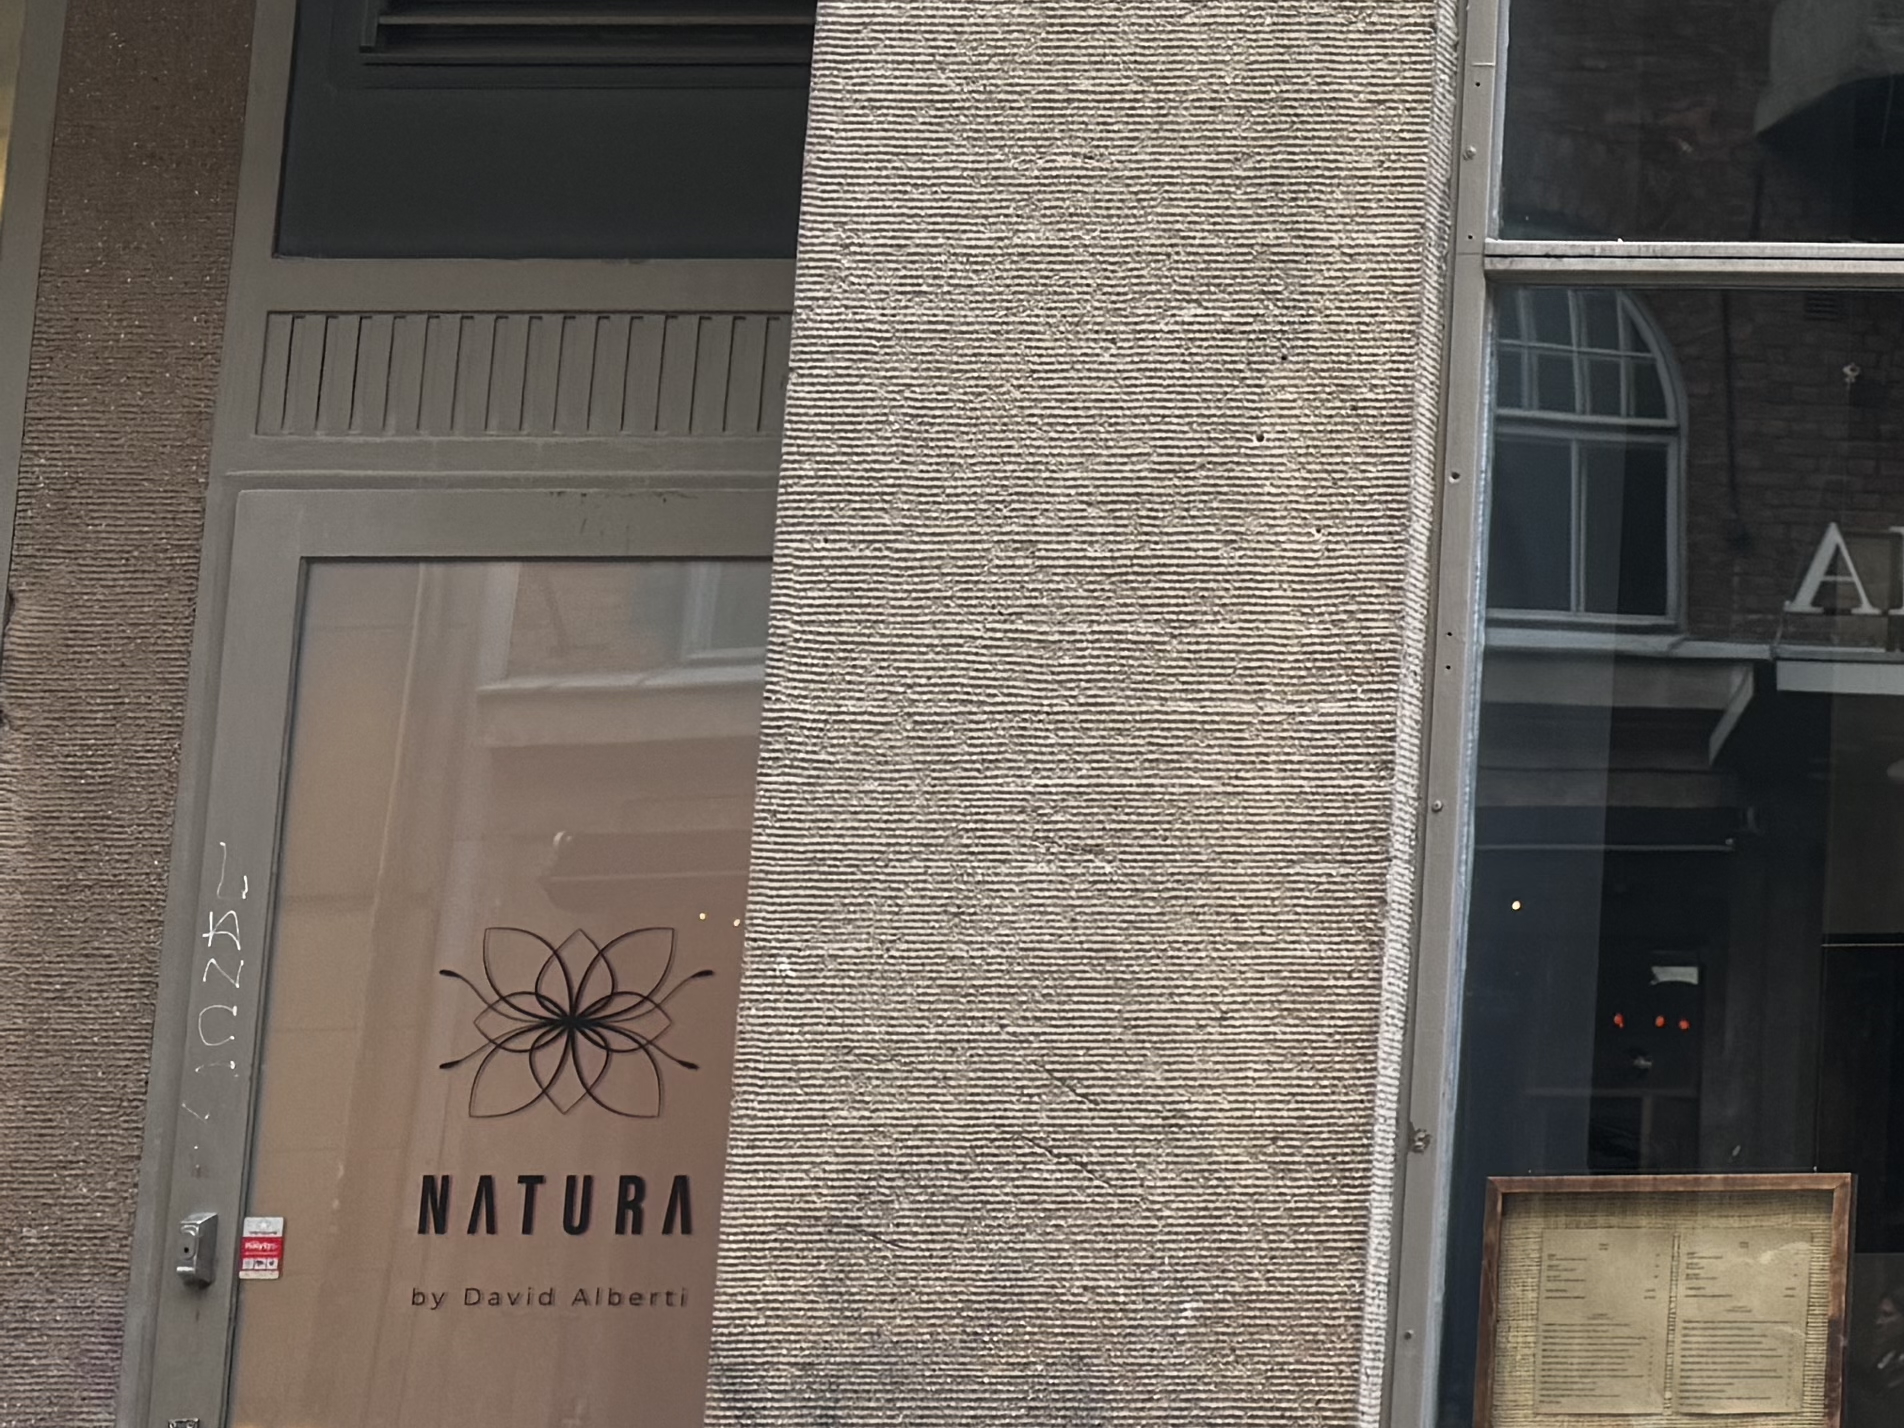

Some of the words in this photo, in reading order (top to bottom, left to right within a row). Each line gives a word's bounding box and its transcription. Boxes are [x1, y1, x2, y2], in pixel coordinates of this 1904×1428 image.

[417, 1174, 693, 1235] NATURA
[411, 1287, 447, 1310] by
[464, 1286, 555, 1307] David
[571, 1287, 689, 1308] Alberti
